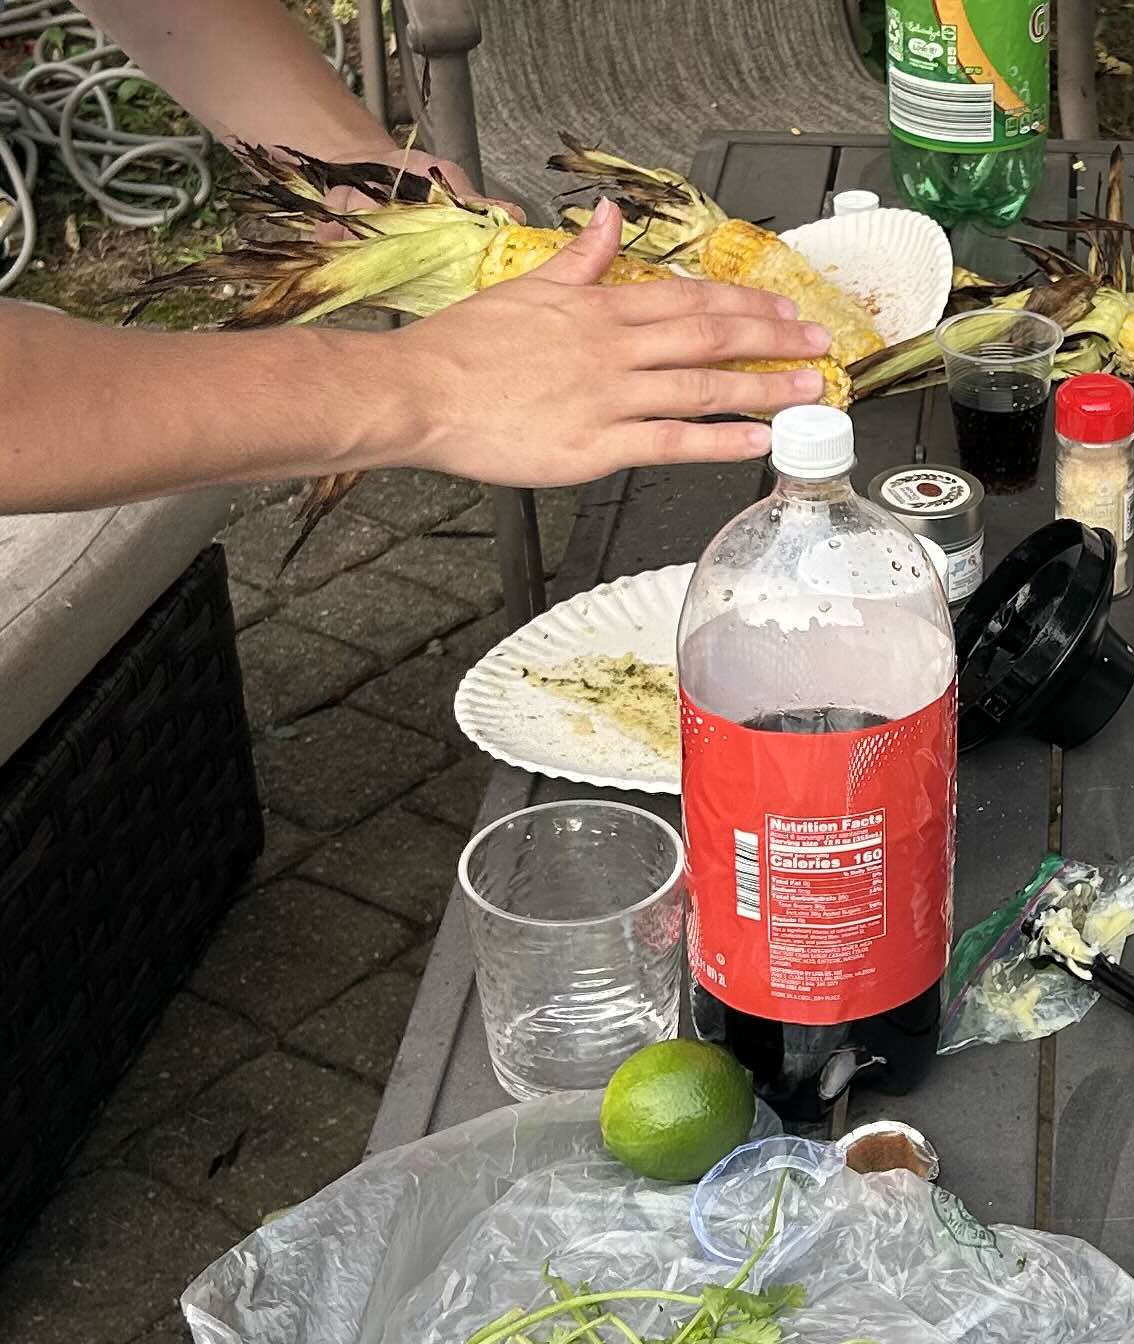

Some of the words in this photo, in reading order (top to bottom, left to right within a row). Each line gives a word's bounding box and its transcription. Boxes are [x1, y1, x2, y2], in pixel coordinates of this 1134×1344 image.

[770, 818, 838, 833] Nutrition
[842, 815, 882, 831] Facts
[770, 855, 840, 869] Calories
[854, 848, 882, 864] 160
